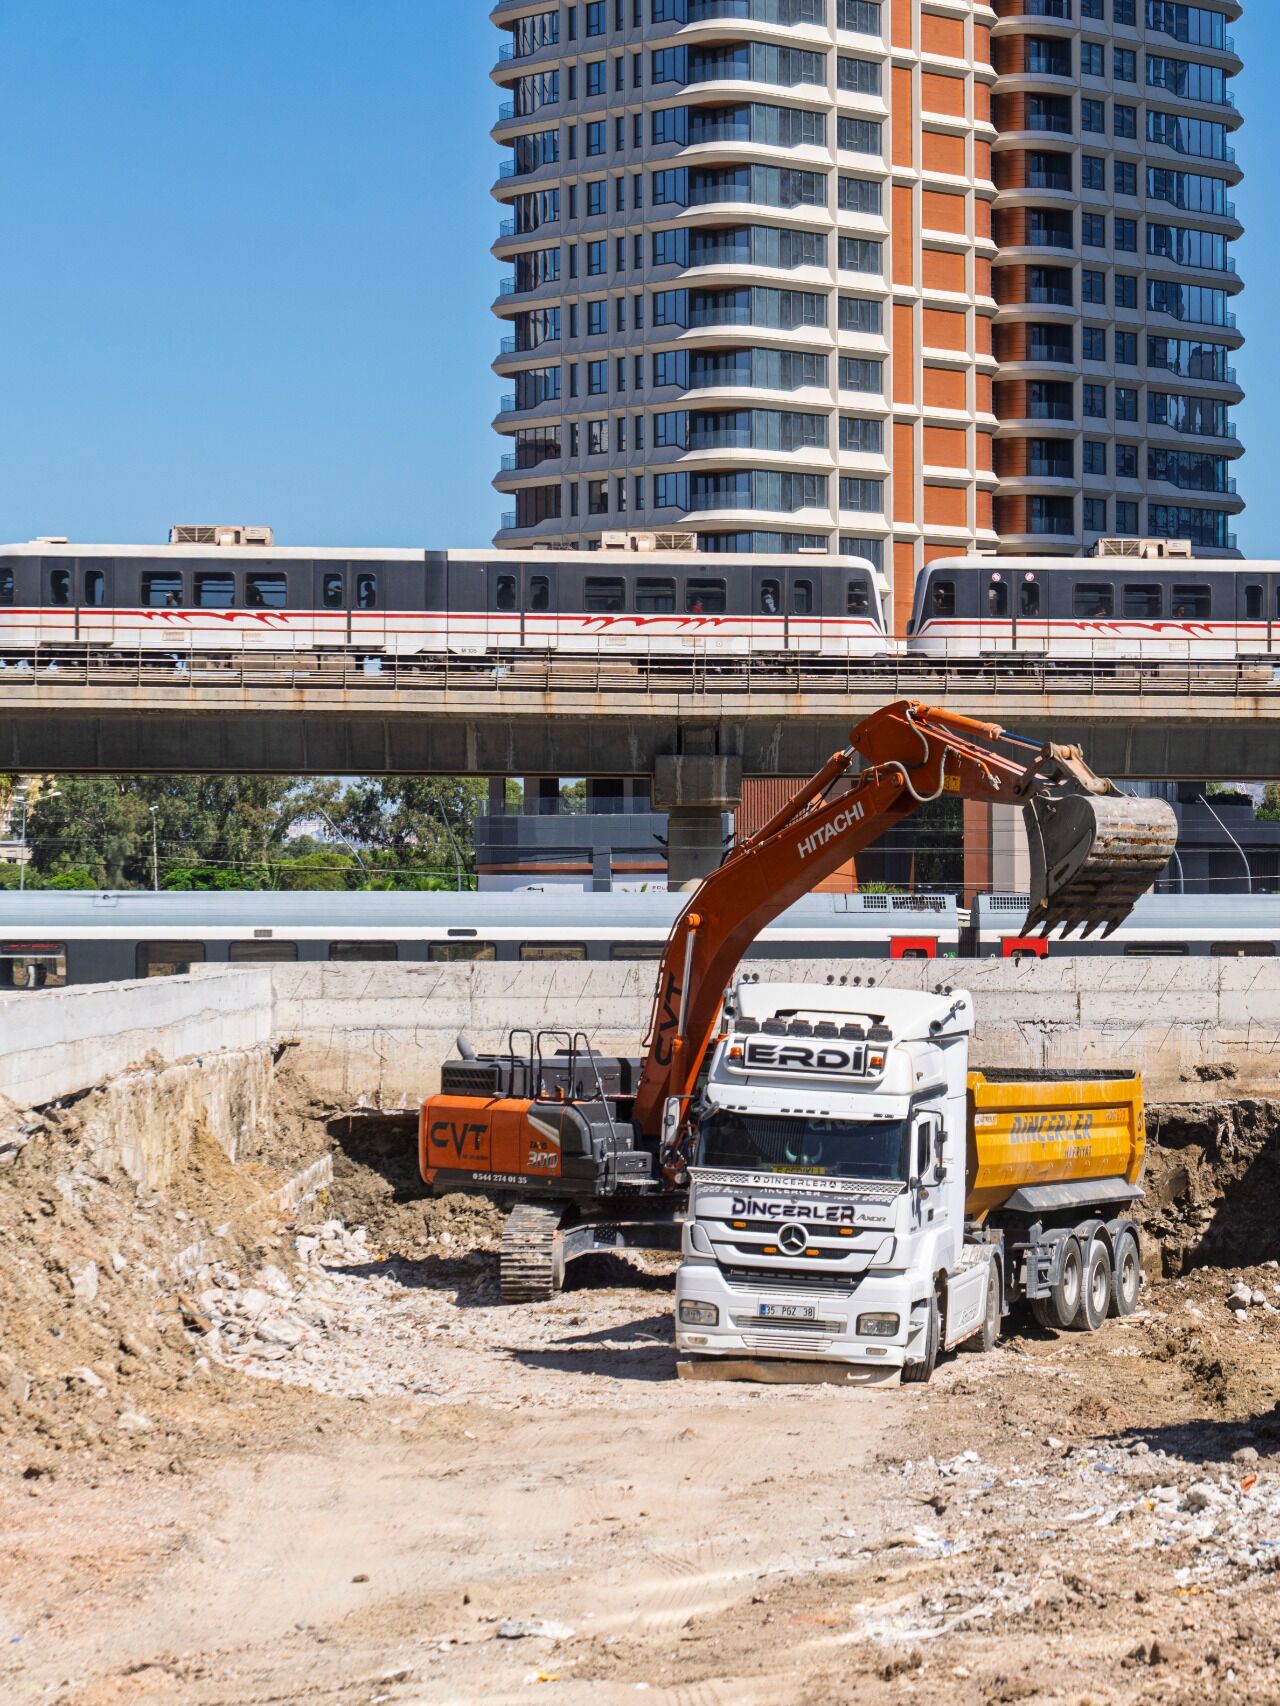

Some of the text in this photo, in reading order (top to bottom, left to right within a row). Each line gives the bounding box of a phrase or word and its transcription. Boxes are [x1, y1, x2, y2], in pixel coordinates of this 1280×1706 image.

[797, 801, 865, 859] HITACHI
[655, 971, 682, 1066] CVT
[748, 1043, 863, 1070] ERDİ
[431, 1121, 488, 1160] CVT
[1010, 1113, 1093, 1148] DİNÇERLER
[527, 1151, 558, 1168] 300
[492, 1174, 507, 1182] 274
[507, 1175, 516, 1183] 01
[517, 1176, 528, 1184] 35
[731, 1195, 855, 1224] DİNÇERLER
[766, 1306, 813, 1317] 35 PGZ 38
